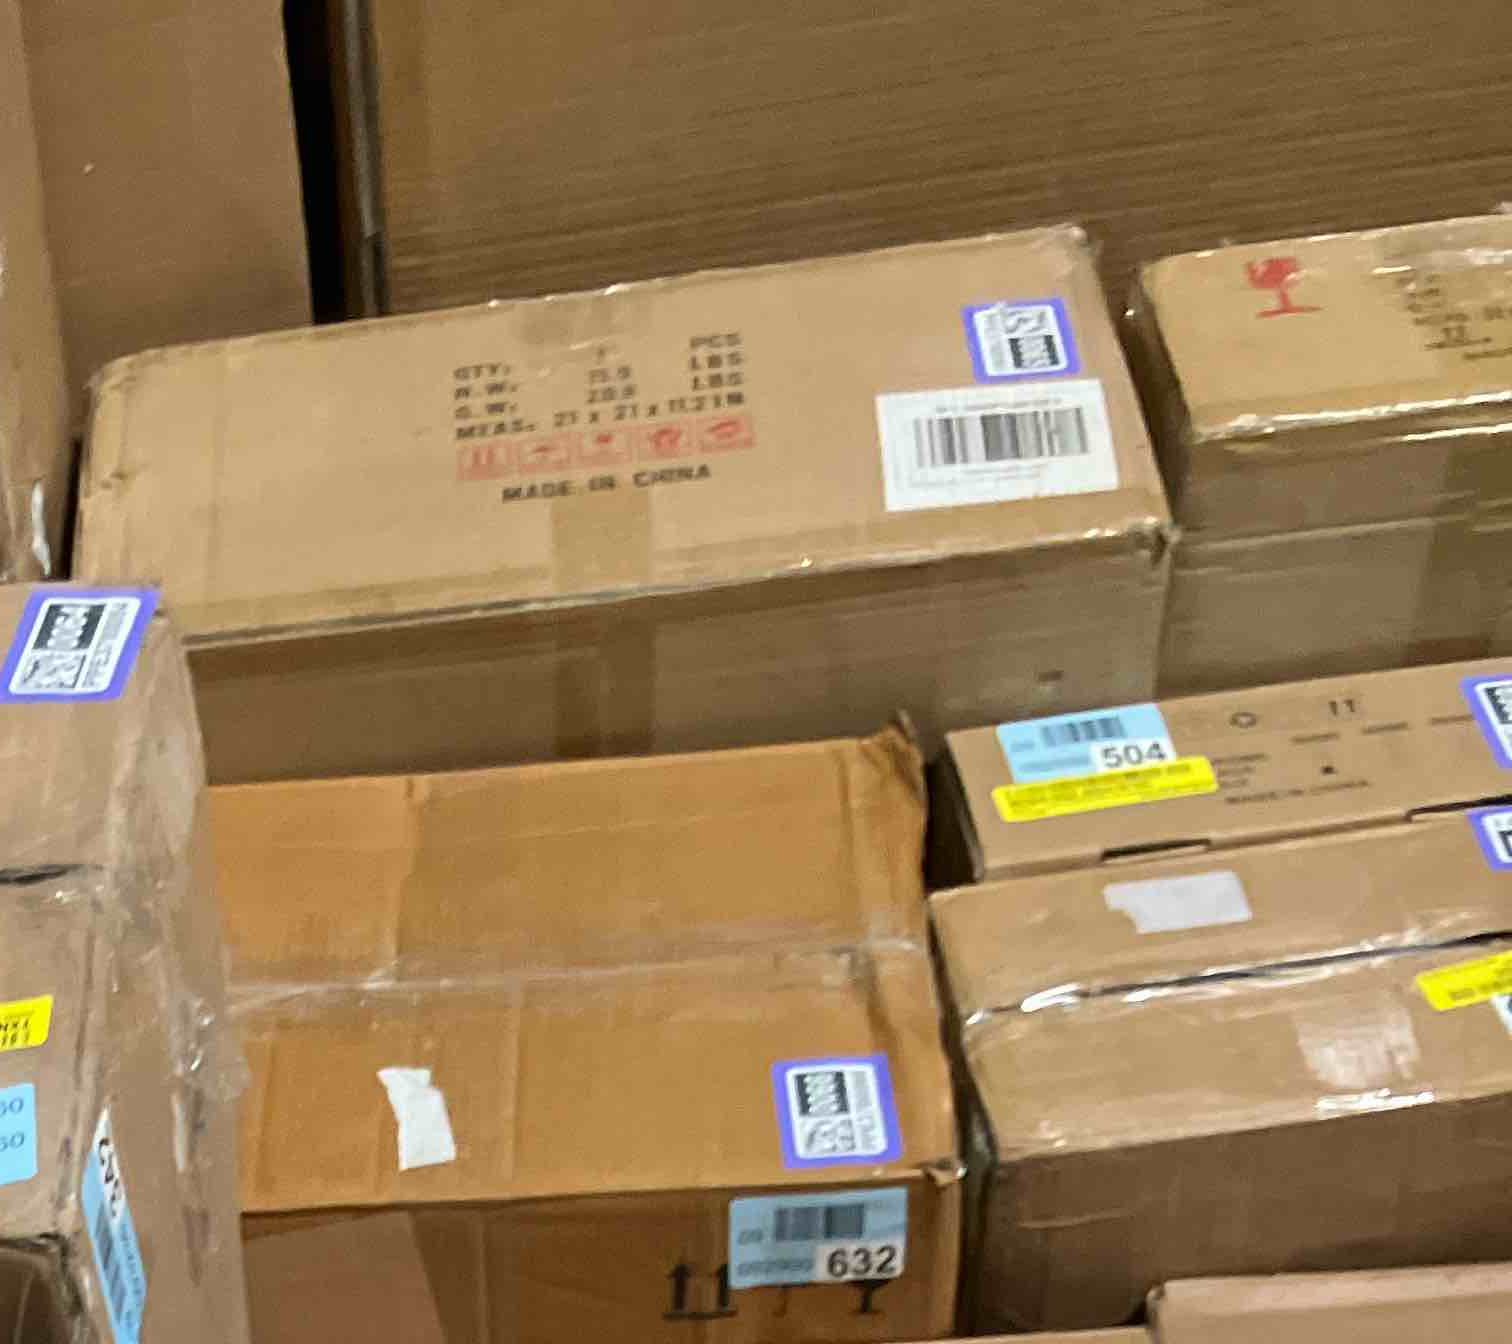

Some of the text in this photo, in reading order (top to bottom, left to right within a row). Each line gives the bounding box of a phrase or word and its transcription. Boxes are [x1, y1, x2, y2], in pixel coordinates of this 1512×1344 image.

[501, 480, 572, 502] MADE
[633, 462, 712, 489] CHINA
[1101, 742, 1167, 769] 504
[826, 1245, 898, 1279] 632
